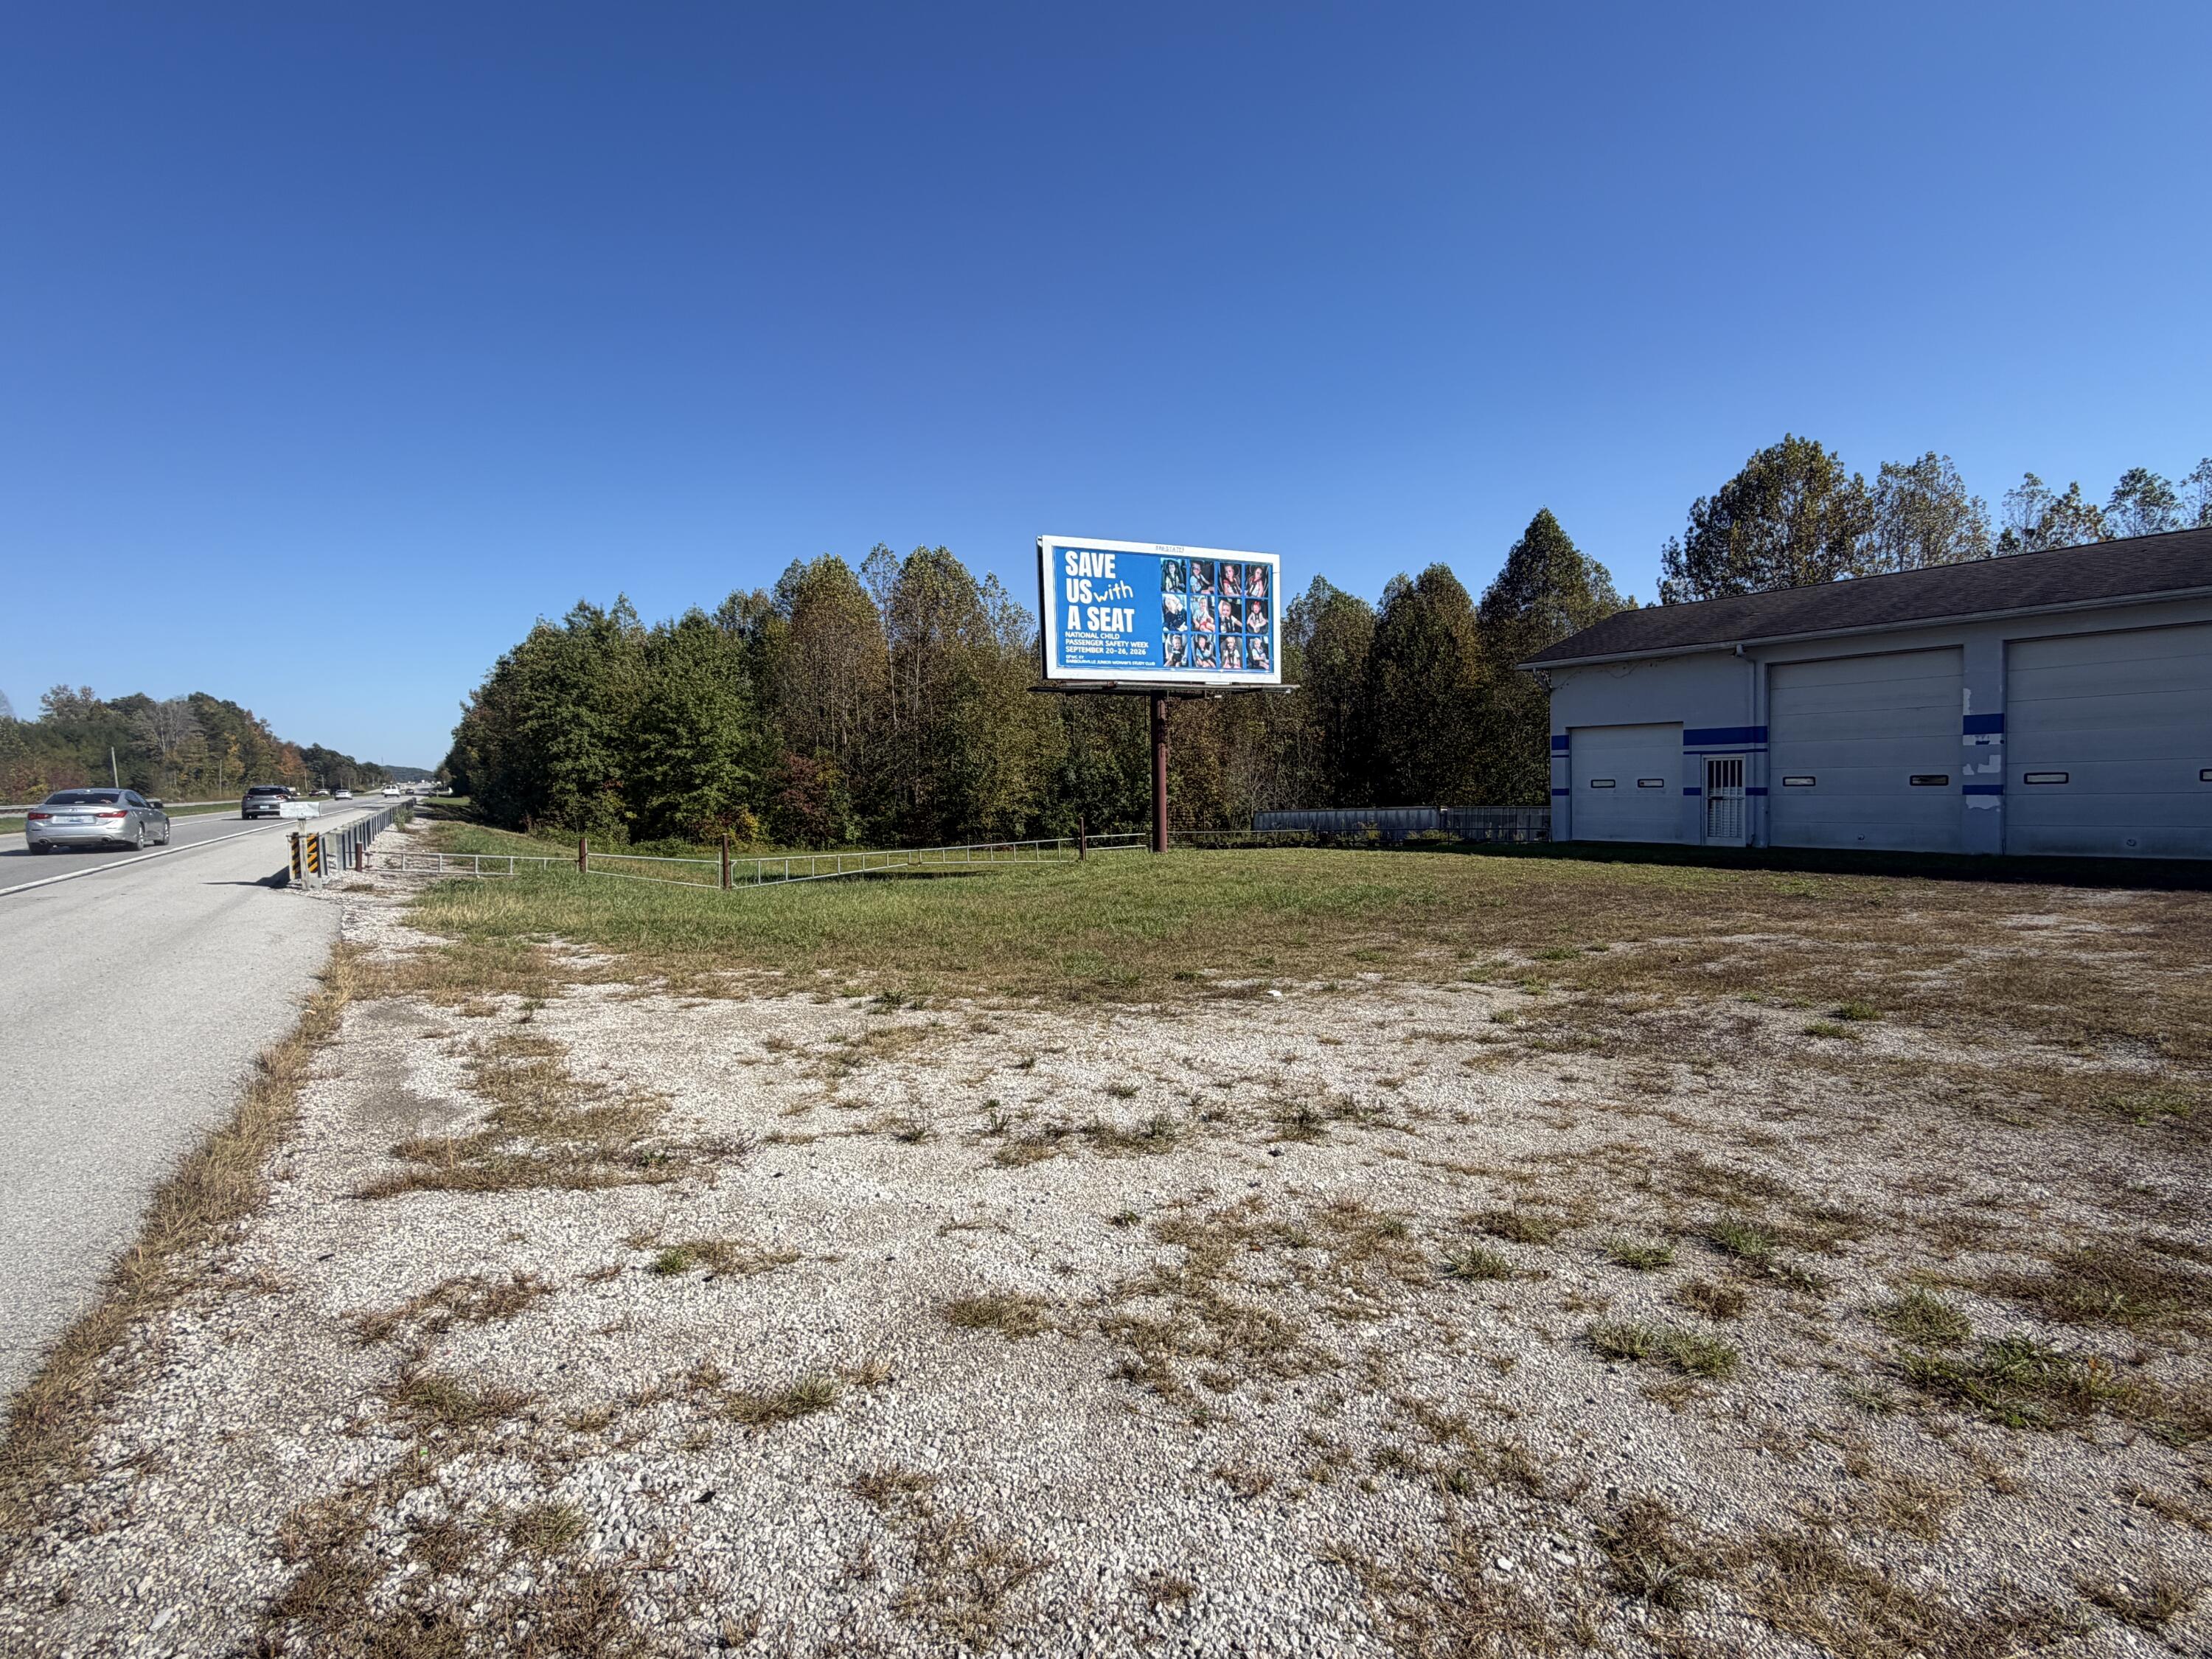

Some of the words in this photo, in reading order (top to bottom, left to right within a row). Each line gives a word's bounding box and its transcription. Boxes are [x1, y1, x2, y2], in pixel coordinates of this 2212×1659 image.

[1065, 550, 1116, 579] SAVE
[1066, 577, 1093, 604] US
[1093, 580, 1133, 602] with
[1067, 605, 1082, 630] A
[1087, 606, 1135, 633] SEAT
[1065, 639, 1103, 647] PASSENGER
